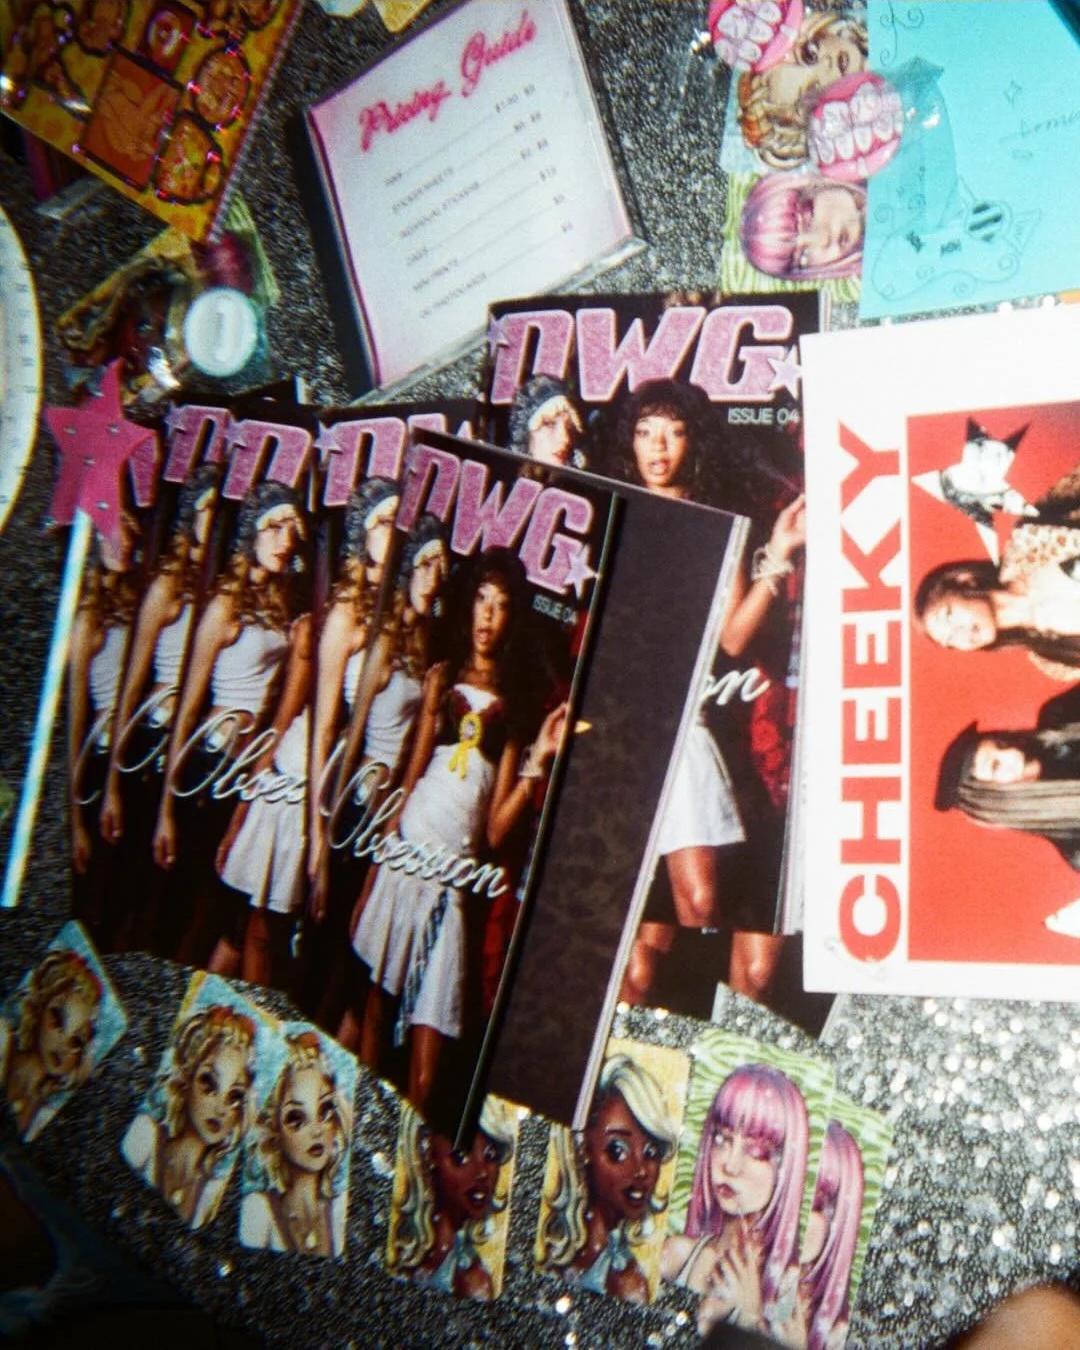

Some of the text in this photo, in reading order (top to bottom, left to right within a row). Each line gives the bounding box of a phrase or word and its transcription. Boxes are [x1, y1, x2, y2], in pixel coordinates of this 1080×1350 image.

[357, 79, 452, 152] Pricing
[727, 406, 800, 425] ISSUE 04
[838, 418, 903, 963] CHEEKY
[329, 761, 509, 899] Obsession
